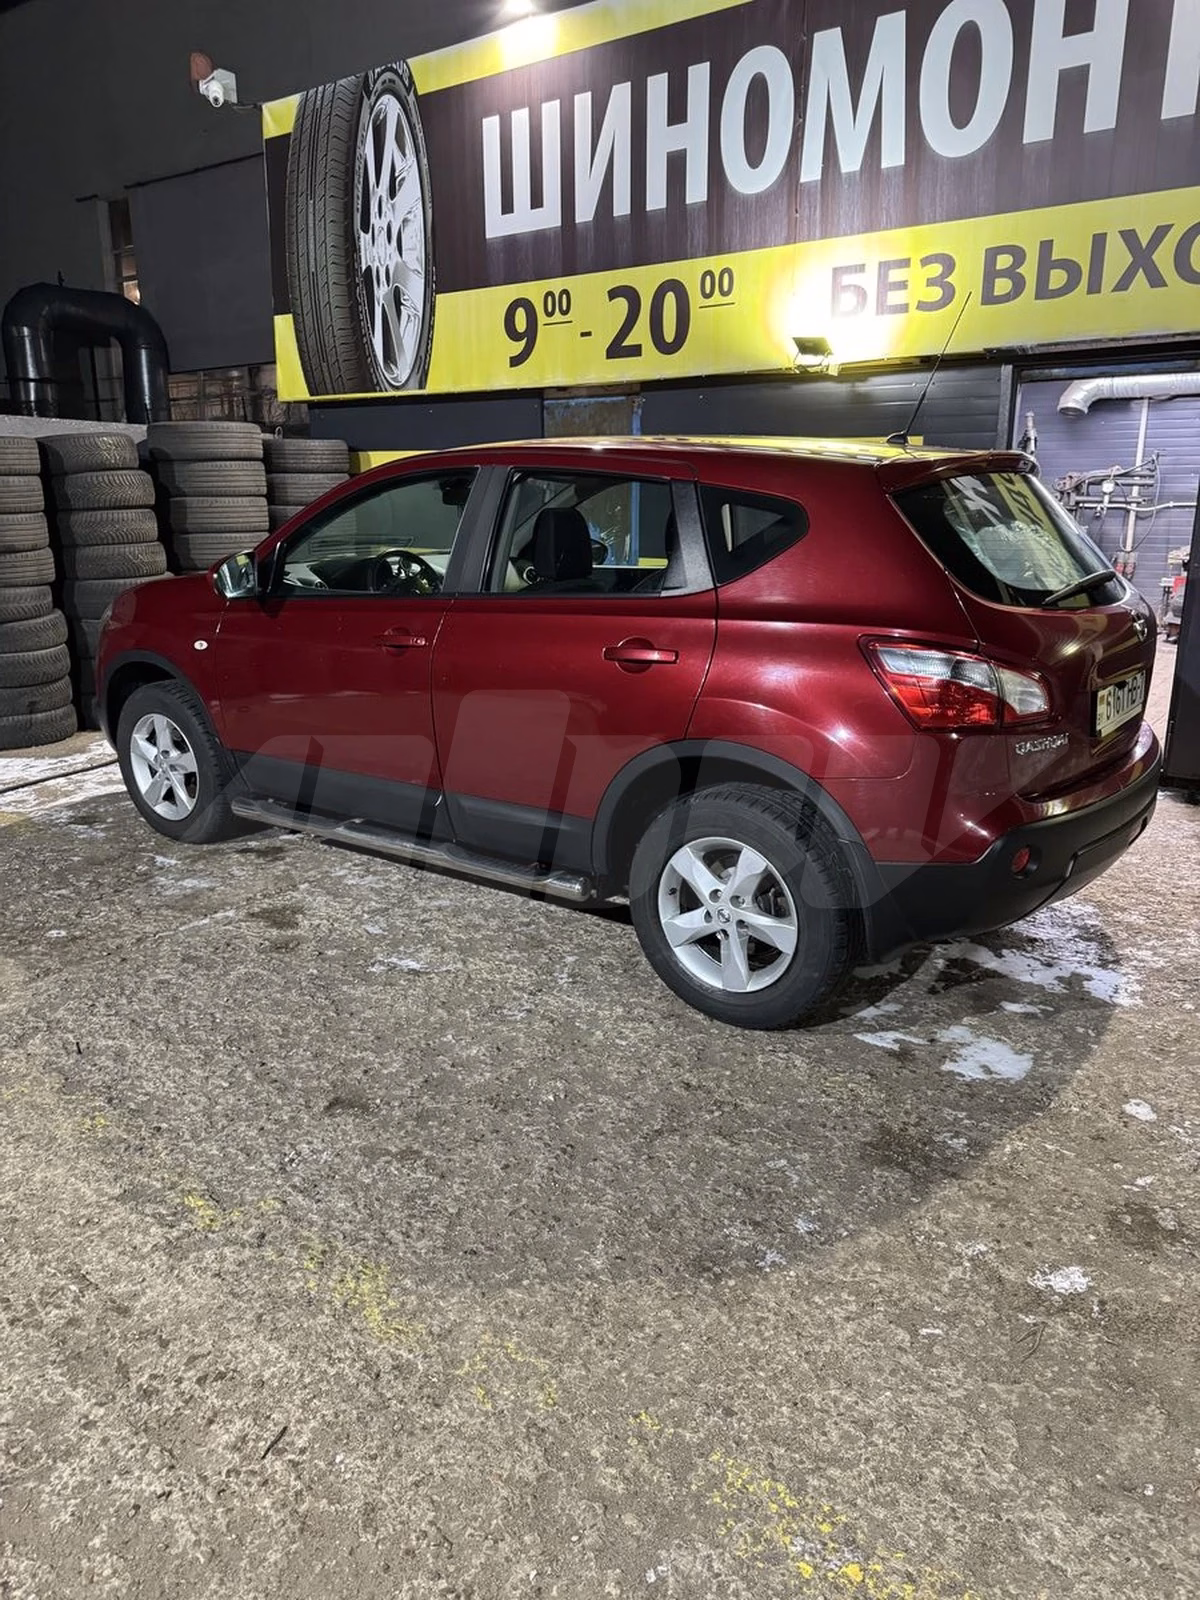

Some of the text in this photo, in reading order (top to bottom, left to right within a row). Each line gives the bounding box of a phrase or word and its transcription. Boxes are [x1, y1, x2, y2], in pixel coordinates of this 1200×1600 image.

[482, 0, 1200, 239] ШИНОМОН
[830, 252, 956, 319] БЕЗ
[1015, 733, 1069, 756] QASHQAI
